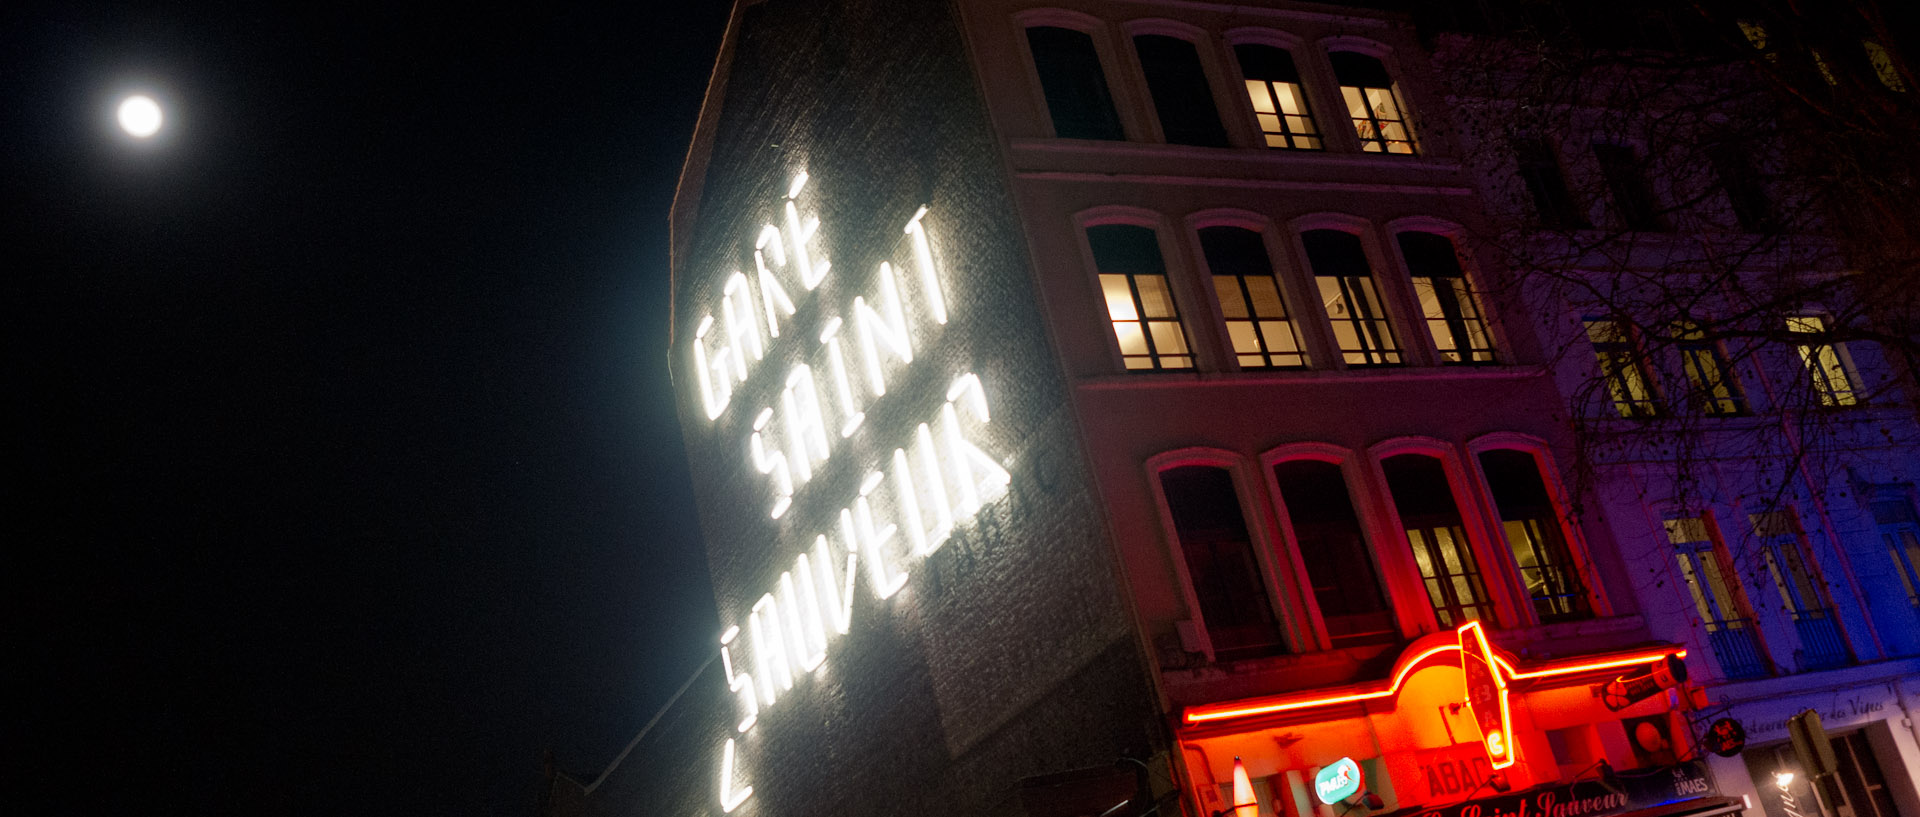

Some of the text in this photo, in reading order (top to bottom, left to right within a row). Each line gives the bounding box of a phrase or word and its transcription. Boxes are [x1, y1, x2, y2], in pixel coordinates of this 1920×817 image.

[751, 203, 948, 520] SAINT
[720, 372, 1012, 733] SAUVEUR
[1535, 791, 1628, 817] Sauveur
[1680, 777, 1708, 795] MAES
